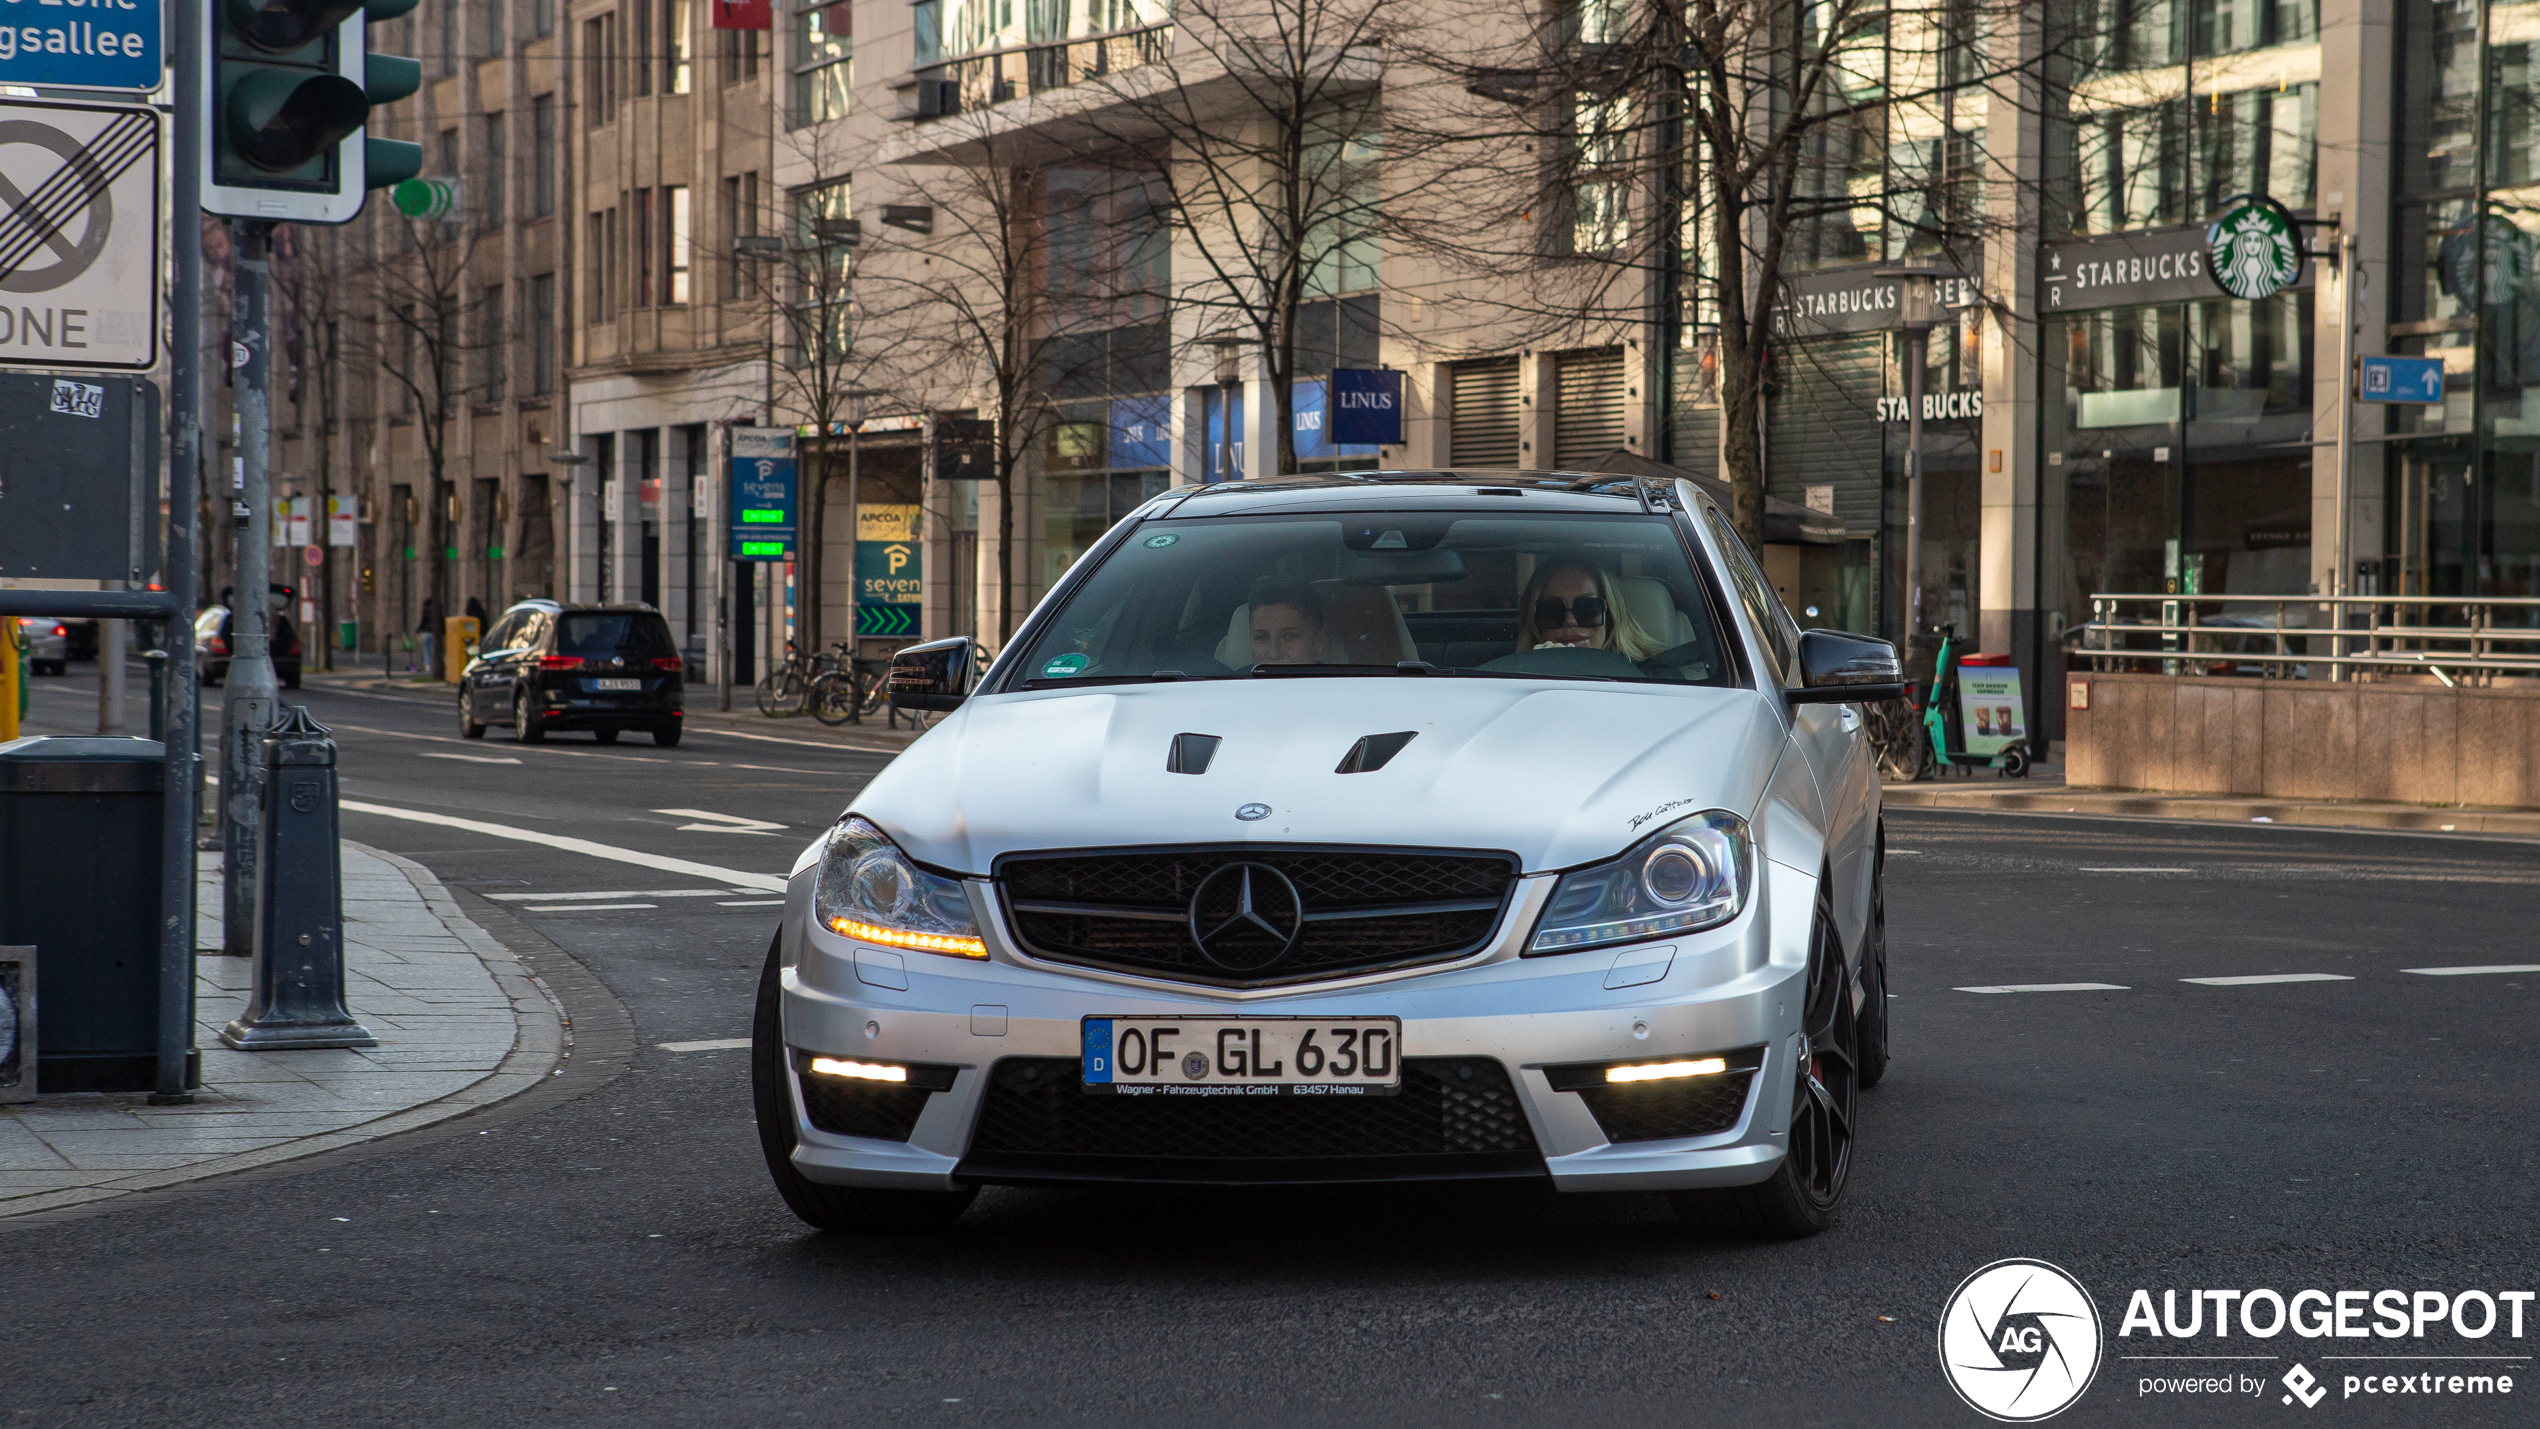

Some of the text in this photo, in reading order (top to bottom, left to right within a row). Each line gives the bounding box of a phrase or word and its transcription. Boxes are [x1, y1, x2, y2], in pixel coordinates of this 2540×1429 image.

[2076, 250, 2200, 288] STARBUCKS
[1796, 285, 1896, 318] STARBUCKS
[2051, 286, 2061, 306] R
[1341, 391, 1392, 409] LINUS
[1876, 390, 1982, 422] STABUCKS
[1296, 411, 1321, 431] LINUS
[861, 513, 901, 522] APCOA
[865, 579, 920, 592] seven
[1094, 1027, 1392, 1077] D OF GL 630
[1116, 1085, 1155, 1096] Wagner
[1163, 1085, 1244, 1096] Fahrzeugtechnik
[1246, 1085, 1279, 1096] GmbH
[1293, 1085, 1328, 1095] 63457
[1330, 1085, 1364, 1095] Hanau
